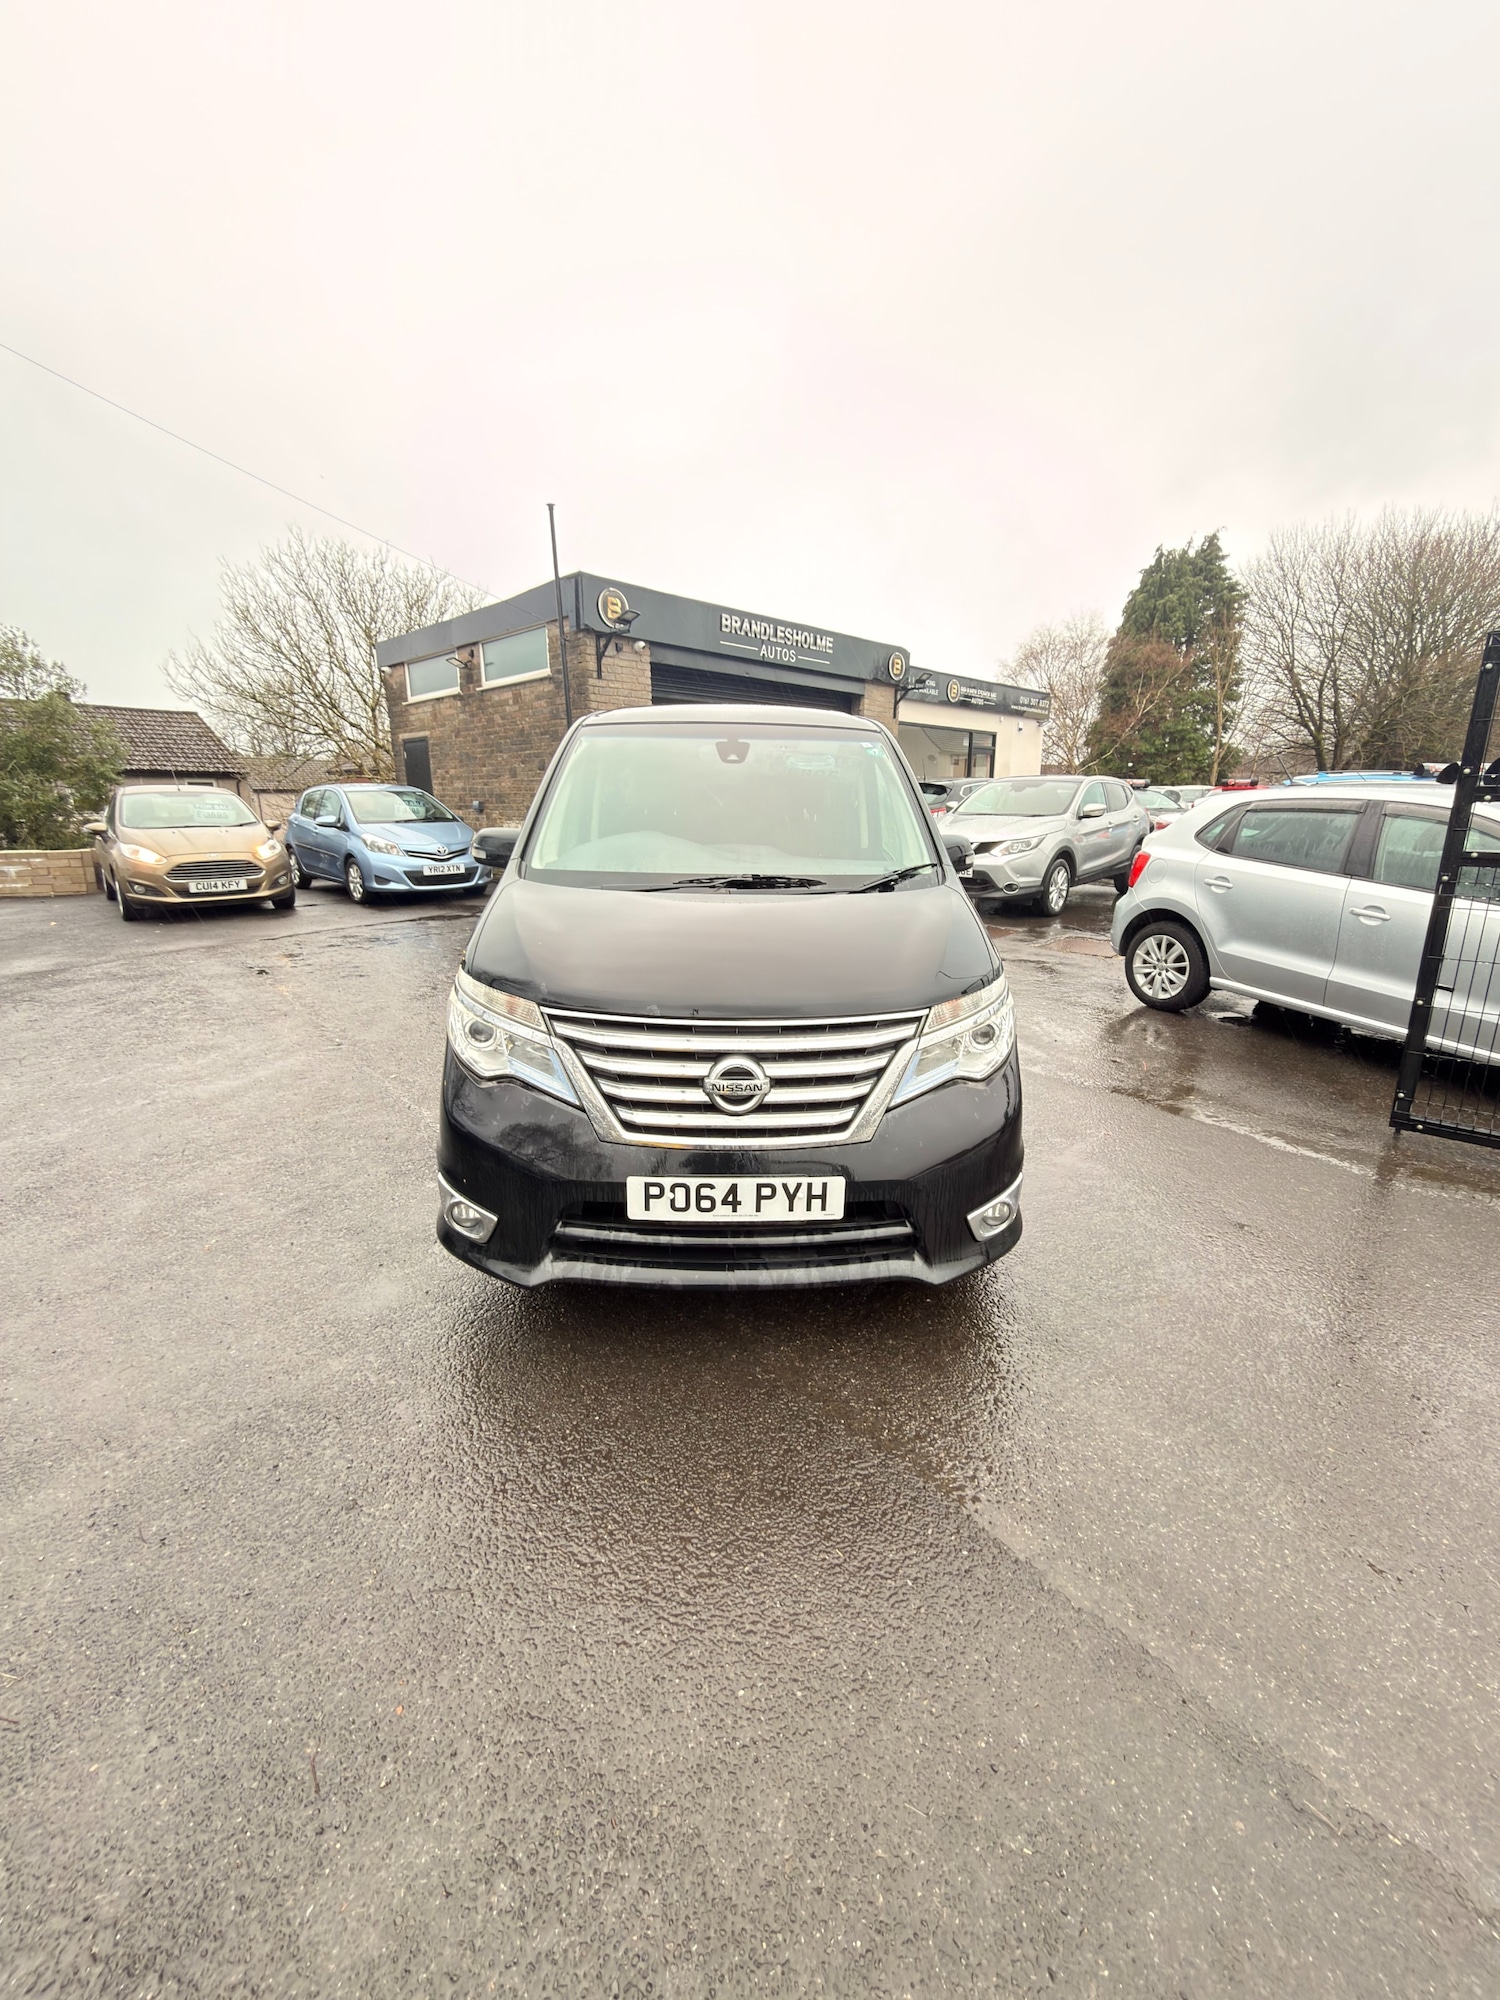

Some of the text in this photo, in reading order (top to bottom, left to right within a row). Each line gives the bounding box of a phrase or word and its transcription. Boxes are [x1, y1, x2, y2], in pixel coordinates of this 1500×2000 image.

[721, 613, 834, 653] BRANDLESHOLME
[760, 644, 796, 662] AUTOS
[428, 864, 461, 874] YR12 XTN
[195, 880, 240, 891] CU14 KFY
[711, 1083, 763, 1092] NISSAN
[644, 1181, 828, 1213] PO64 PYH
